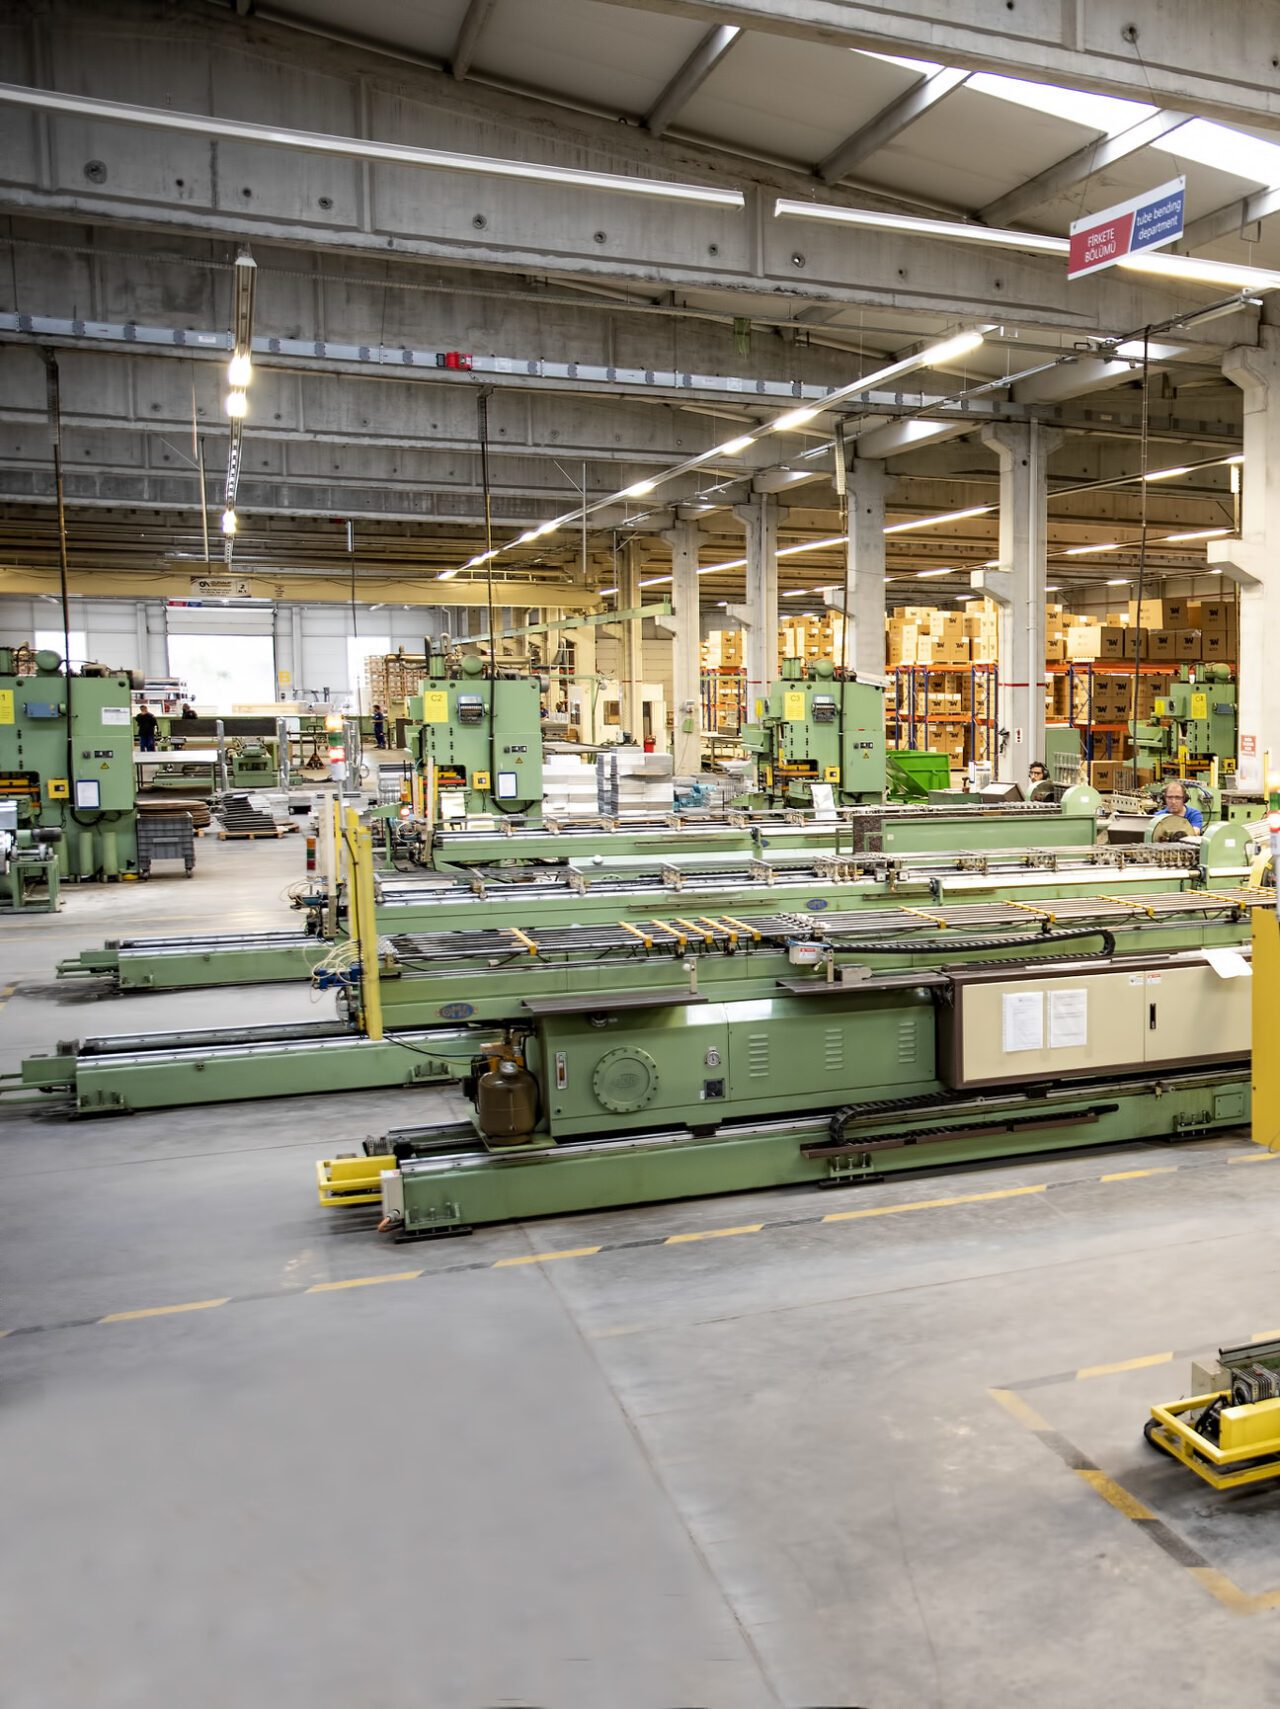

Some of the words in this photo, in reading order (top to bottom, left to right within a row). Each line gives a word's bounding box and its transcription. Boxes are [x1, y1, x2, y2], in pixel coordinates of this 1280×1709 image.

[1137, 213, 1152, 226] tube
[1153, 200, 1181, 219] bending
[1138, 215, 1178, 240] department
[1084, 240, 1116, 263] BÖLÜMÜ
[431, 694, 442, 702] C2
[790, 694, 800, 702] C3
